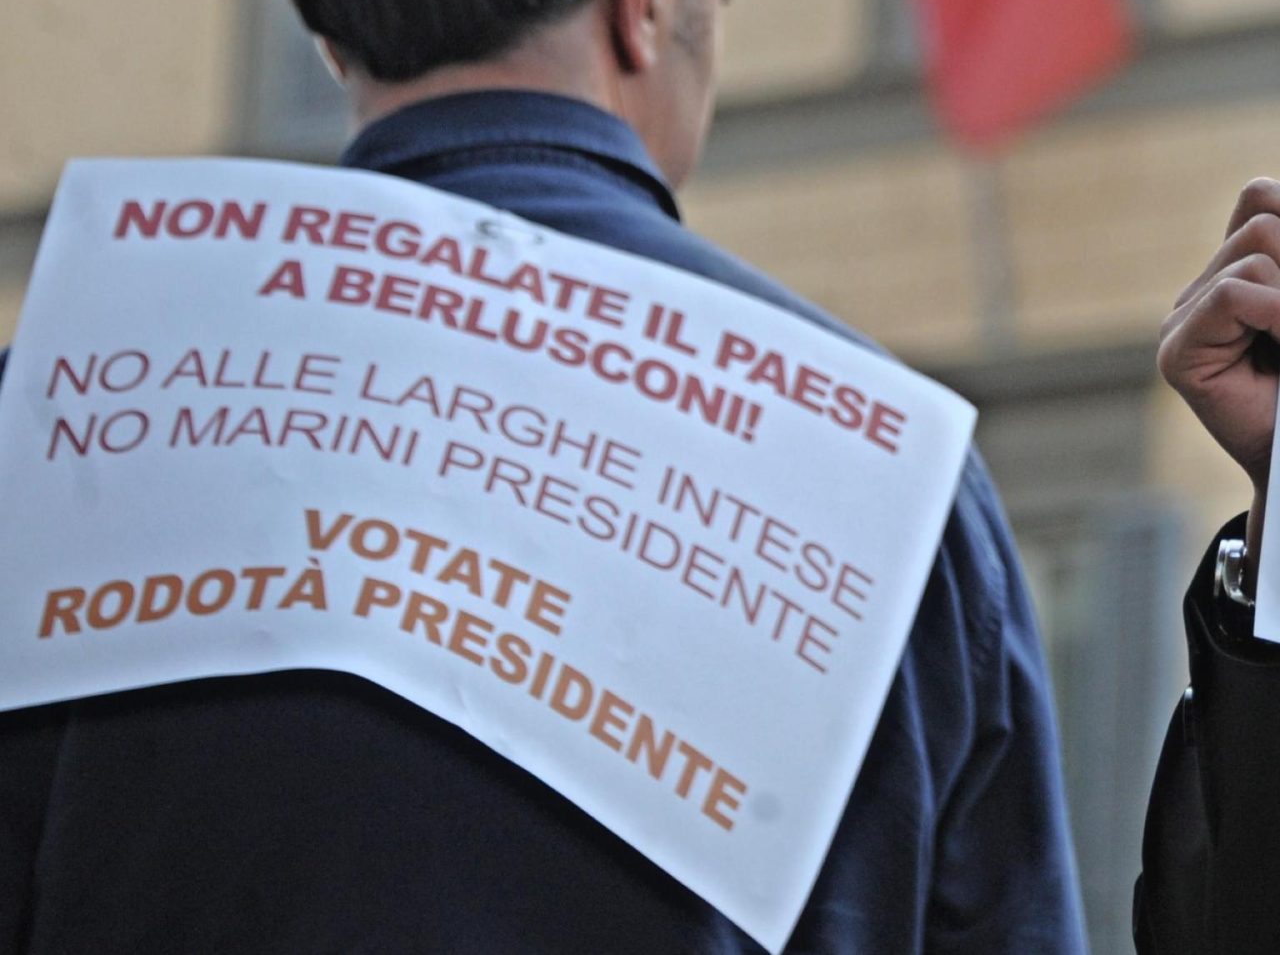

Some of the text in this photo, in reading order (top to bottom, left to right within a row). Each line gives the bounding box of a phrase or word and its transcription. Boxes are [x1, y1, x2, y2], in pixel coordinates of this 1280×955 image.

[113, 199, 907, 454] NON REGALATE IL PAESE
[257, 259, 764, 443] A BERLUSCONI!
[47, 348, 873, 620] NO ALLE LARGHE INTESE
[48, 407, 836, 673] NO MARINI PRESIDENTE
[303, 508, 571, 636] VOTATE
[37, 556, 748, 832] RODOTÀ PRESIDENTE
